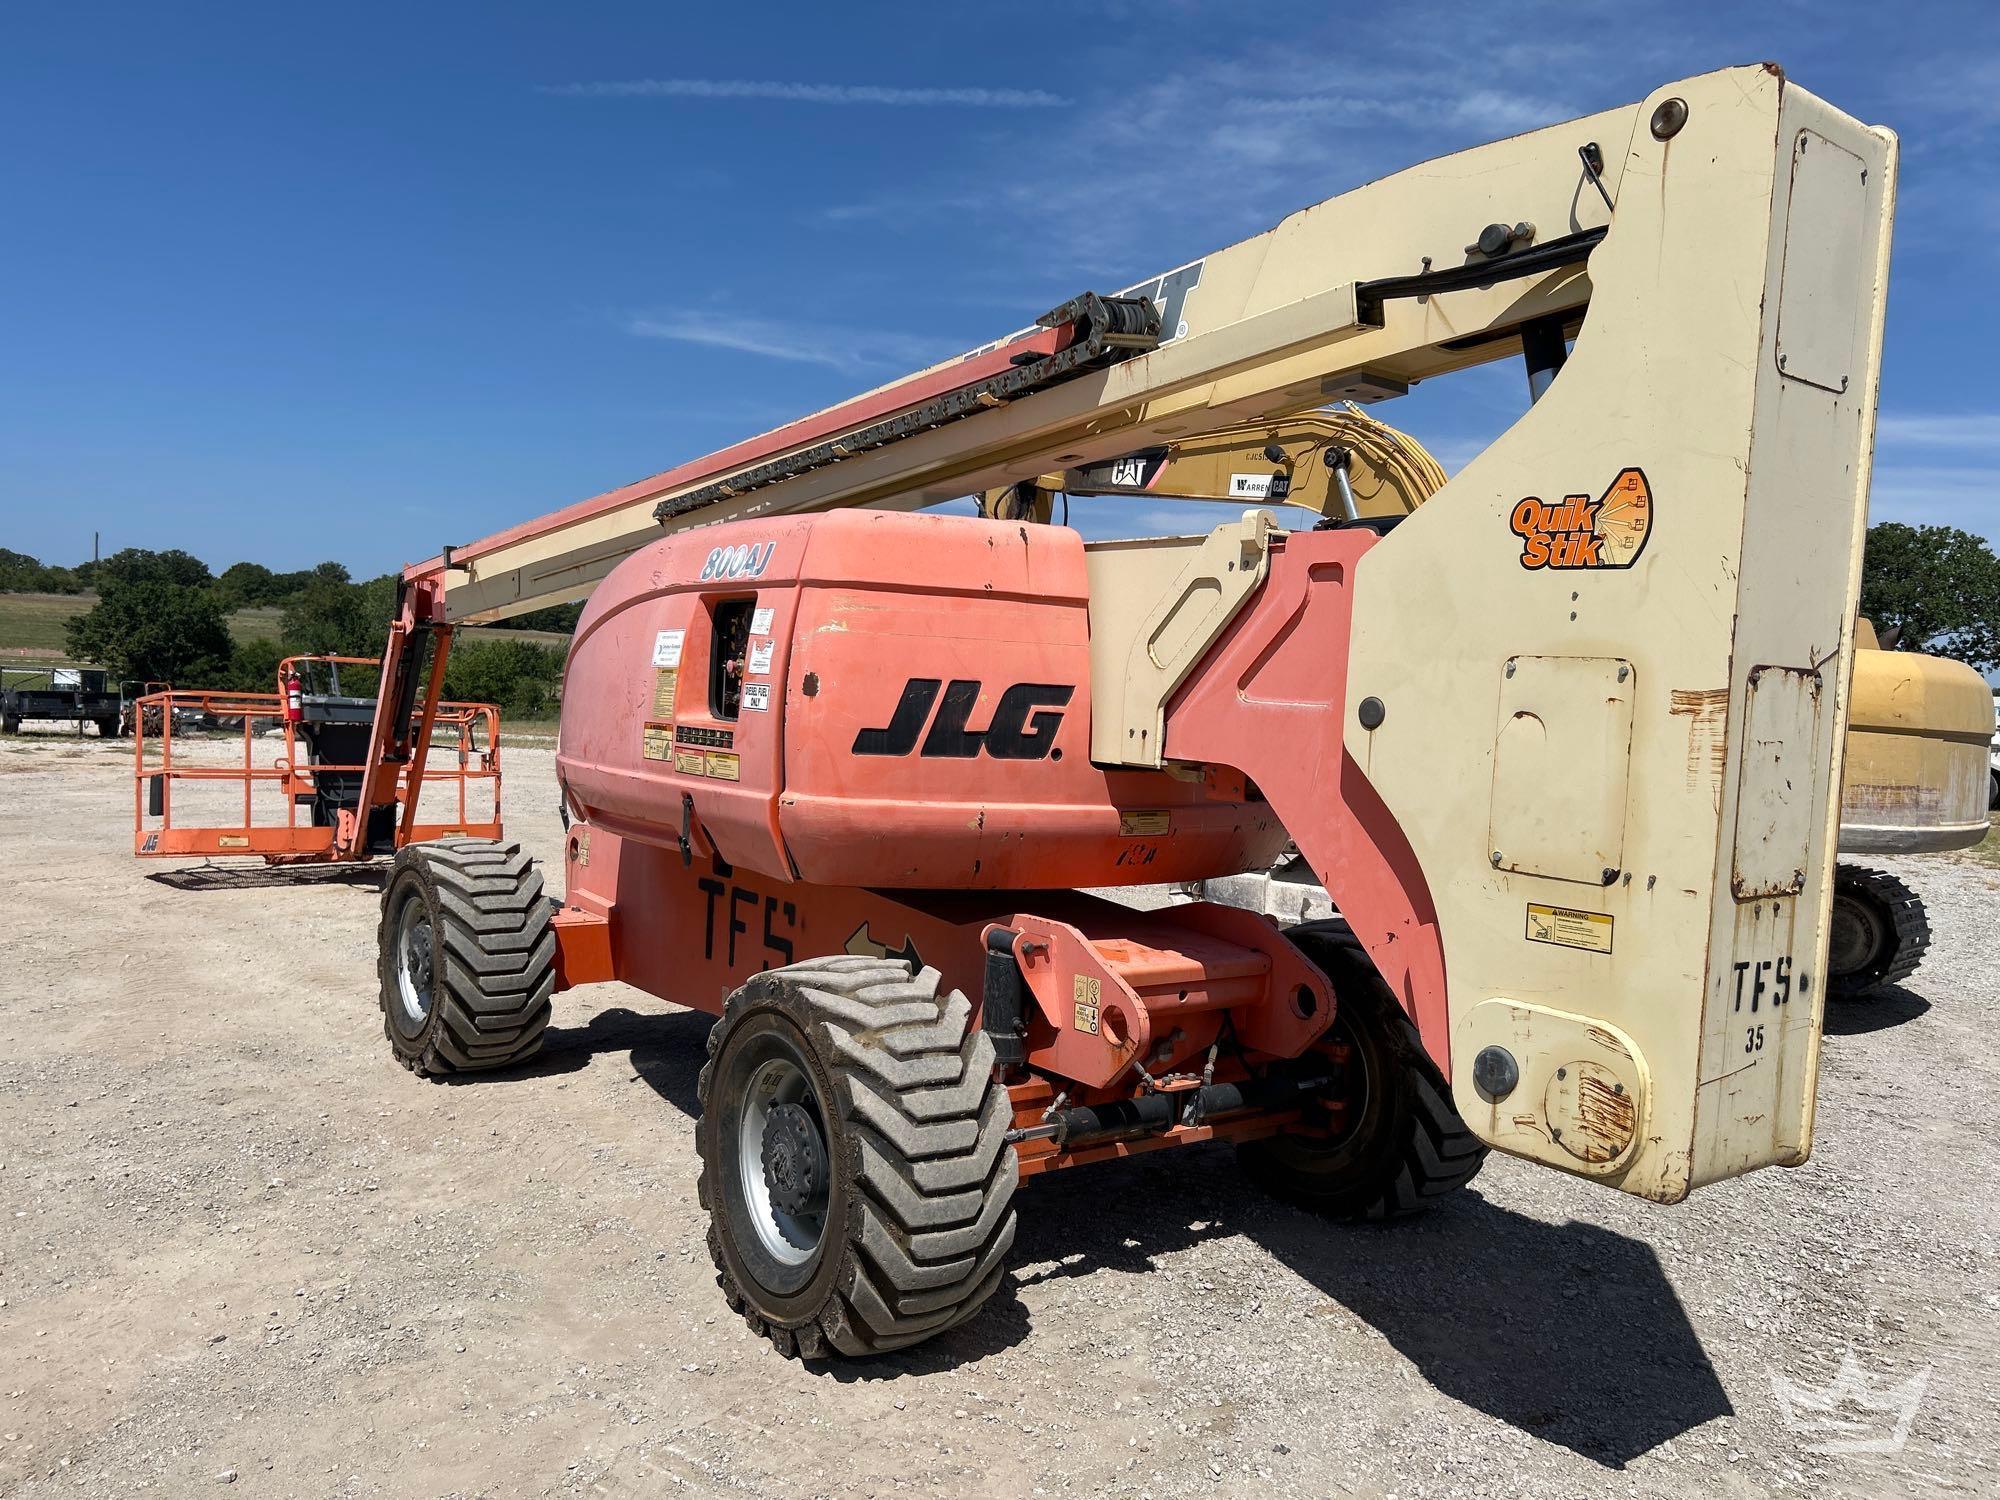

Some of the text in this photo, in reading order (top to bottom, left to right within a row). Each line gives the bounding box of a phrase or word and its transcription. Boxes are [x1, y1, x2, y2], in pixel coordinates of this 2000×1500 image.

[1111, 458, 1147, 486] CAT
[1236, 479, 1289, 493] WARREN CAT
[1512, 497, 1600, 538] Quik
[700, 541, 776, 581] 800AJ
[1522, 532, 1605, 567] Stik
[699, 877, 796, 971] TFS
[1557, 910, 1590, 921] WARNING
[1733, 956, 1792, 1013] TFS
[1745, 1024, 1765, 1054] 35
